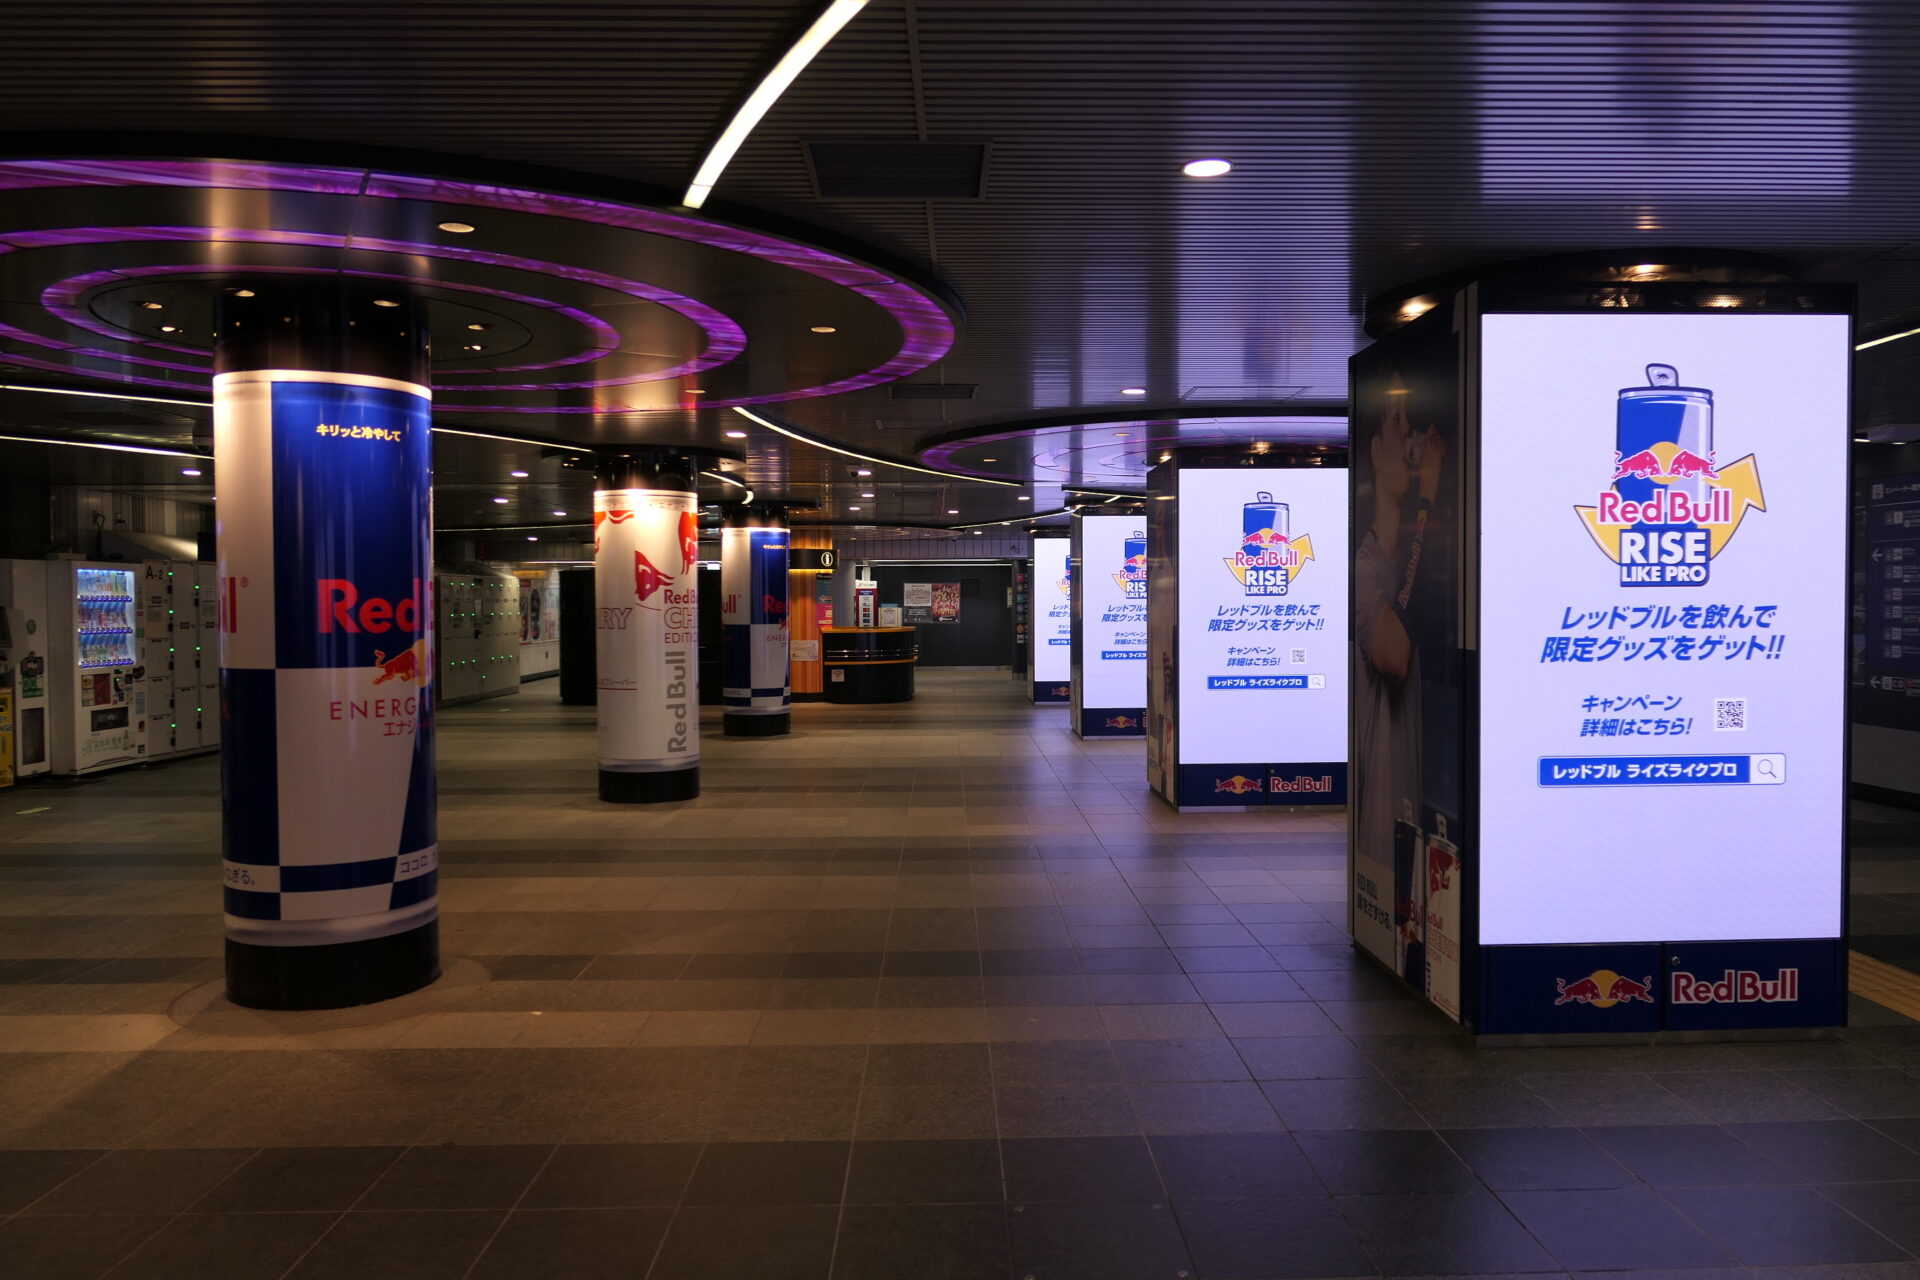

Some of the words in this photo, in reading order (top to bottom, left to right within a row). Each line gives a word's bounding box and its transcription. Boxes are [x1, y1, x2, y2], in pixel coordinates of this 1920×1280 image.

[316, 424, 401, 442] キリッと冷やして
[1600, 490, 1662, 522] Red
[1669, 490, 1730, 522] Bull
[1621, 531, 1707, 564] RISE
[1235, 551, 1266, 566] Red
[1268, 550, 1298, 566] Bull
[1245, 570, 1287, 586] RISE
[1622, 566, 1661, 582] LIKE
[1665, 565, 1707, 582] PRO
[1126, 582, 1146, 592] RIS
[1246, 586, 1265, 594] LIKE
[1267, 586, 1287, 594] PRO
[664, 588, 689, 604] Red
[722, 594, 736, 613] ull
[763, 595, 786, 613] Re
[317, 578, 422, 634] Red
[1217, 604, 1321, 616] レッドブルを飲んで
[1561, 604, 1778, 630] レッドブルを飲んで
[1227, 646, 1276, 655] キャンペーン
[1214, 679, 1247, 687] レッドブル
[1249, 679, 1303, 687] ライズライクプロ
[1582, 694, 1682, 713] キャンペーン
[1580, 718, 1693, 737] 詳細はこちら!
[1553, 765, 1621, 779] レッドブル
[1627, 763, 1737, 778] ライズライクプロ
[1271, 776, 1301, 792] Red
[1302, 776, 1332, 792] Bull
[1672, 970, 1735, 1004] Red
[1737, 968, 1798, 1003] Bull
